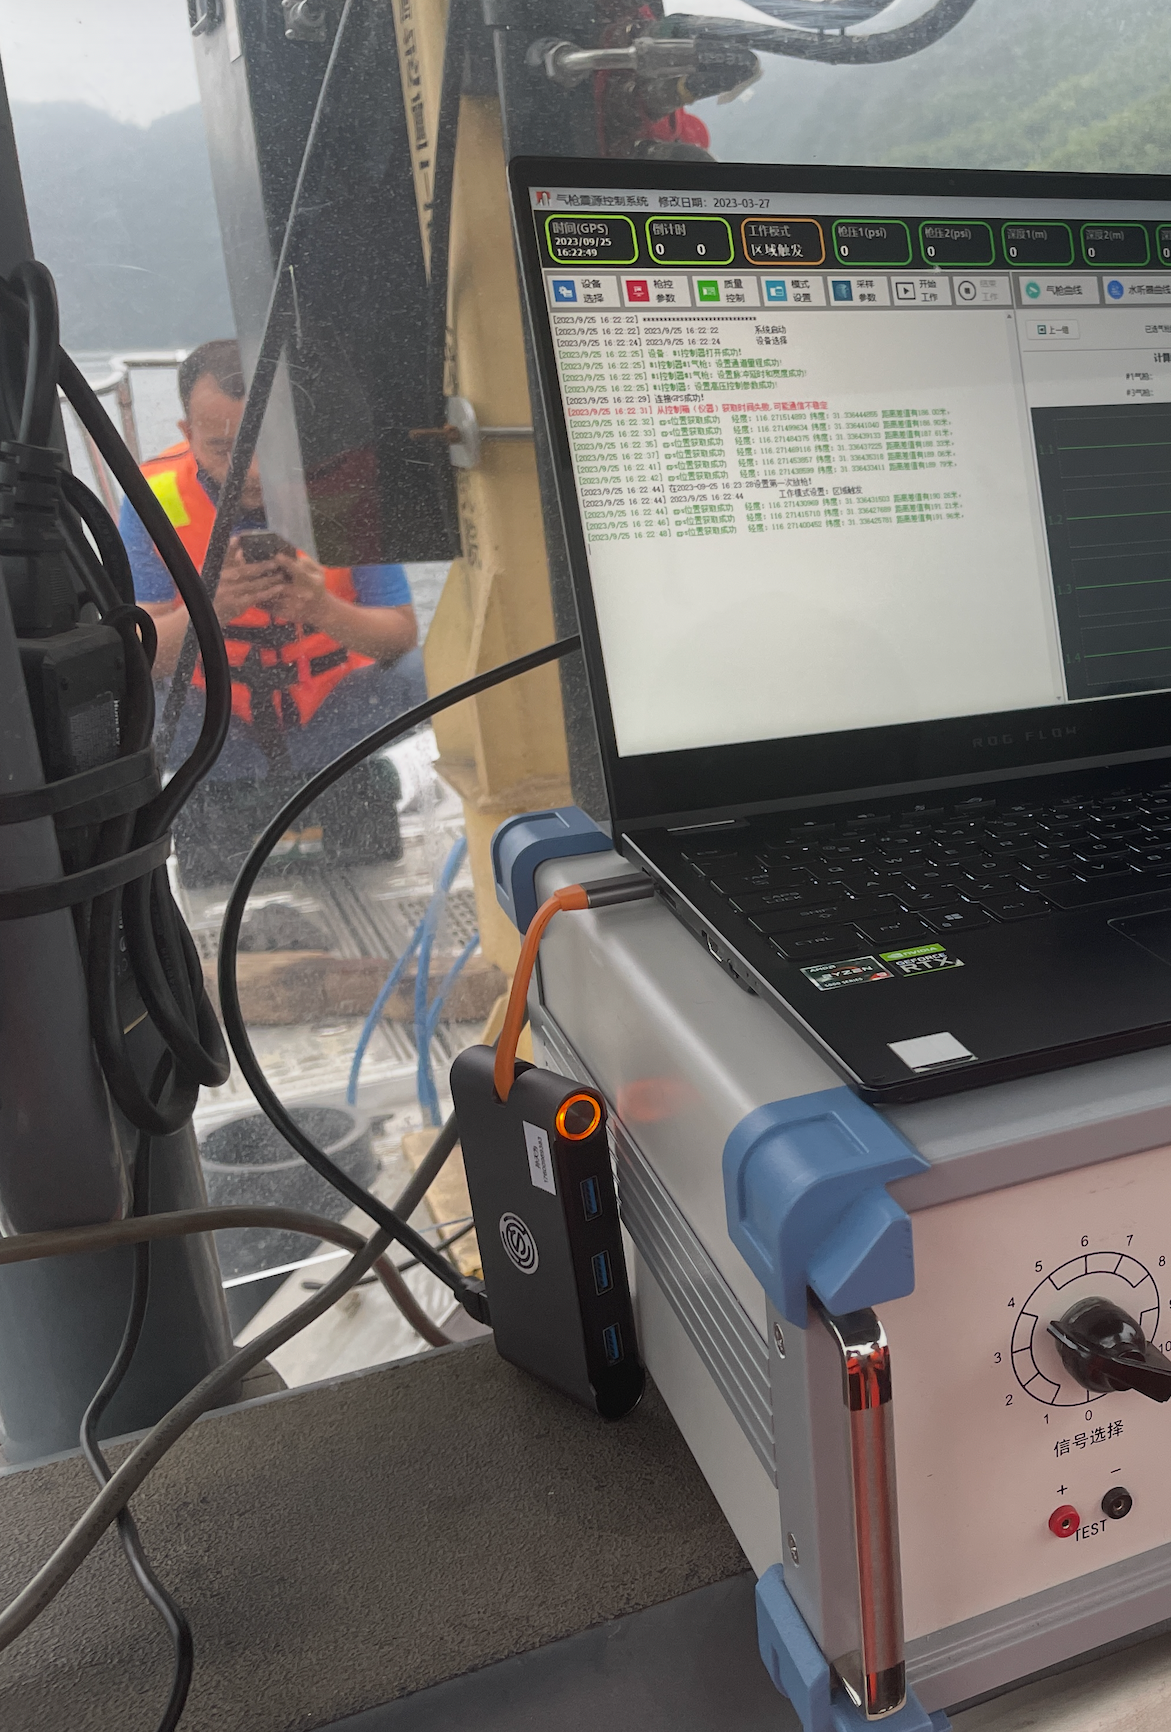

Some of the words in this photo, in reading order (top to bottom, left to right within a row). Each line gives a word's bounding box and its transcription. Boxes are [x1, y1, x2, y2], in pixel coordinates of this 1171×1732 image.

[713, 198, 770, 209] 2023-03-27
[653, 224, 686, 237] 倒计时
[749, 224, 791, 237] 工作模式
[838, 226, 887, 239] 枪压1(psi)
[925, 227, 972, 240] 枪压2(psi)
[555, 237, 612, 247] 2023/09/25
[557, 248, 597, 257] 16:22:49
[656, 244, 664, 256] 0
[697, 244, 706, 256] 0
[752, 244, 804, 258] 区域触发
[841, 246, 849, 257] 0
[927, 246, 935, 257] 0
[1010, 247, 1017, 257] 0
[1088, 247, 1096, 258] 0
[1163, 248, 1171, 258] 0
[581, 279, 602, 290] 设备
[653, 279, 673, 289] 枪控
[724, 279, 743, 289] 质量
[791, 279, 810, 289] 模式
[856, 279, 875, 289] 采样
[919, 279, 936, 289] 开始
[1047, 285, 1083, 296] 气枪曲线
[584, 293, 604, 303] 选择
[656, 293, 676, 303] 参数
[726, 293, 745, 303] 控制
[793, 292, 812, 302] 设置
[859, 292, 877, 302] 参数
[921, 292, 938, 302] 工作
[553, 315, 596, 325] [2023/9/25
[600, 315, 639, 324] 16:22:22]
[555, 326, 598, 336] [2023/9/25
[602, 326, 640, 336] 16:22:22]
[644, 326, 682, 336] 2023/9/25
[686, 325, 718, 335] 16:22:22
[754, 325, 786, 334] 系统启动
[556, 338, 600, 348] [2023/9/25
[604, 337, 642, 347] 16:22:24]
[646, 337, 684, 347] 2023/9/25
[687, 337, 720, 346] 16:22:24
[755, 336, 787, 345] 设备选择
[566, 395, 609, 406] [2023/9/25
[613, 394, 651, 405] 16:22:29]
[580, 486, 623, 497] [2023/9/25
[627, 484, 665, 495] 16:22:44]
[582, 497, 625, 509] [2023/9/25
[629, 495, 667, 506] 16:22:44]
[670, 493, 707, 504] 2023/9/25
[711, 491, 743, 502] 16:22:44
[972, 734, 1013, 748] ROG
[1025, 726, 1077, 741] FLOW
[896, 952, 946, 966] GEFORCE
[901, 957, 953, 973] RTX
[821, 965, 873, 979] RYZEN
[1081, 1235, 1089, 1247] 6
[1126, 1235, 1134, 1246] 7
[1035, 1261, 1042, 1272] 5
[1158, 1255, 1166, 1267] 8
[1008, 1297, 1015, 1308] 4
[994, 1352, 1002, 1363] 3
[1005, 1395, 1013, 1406] 2
[1044, 1413, 1050, 1424] 1
[1085, 1410, 1092, 1421] 0
[1054, 1419, 1124, 1458] 信号选择
[1074, 1519, 1107, 1542] TEST
